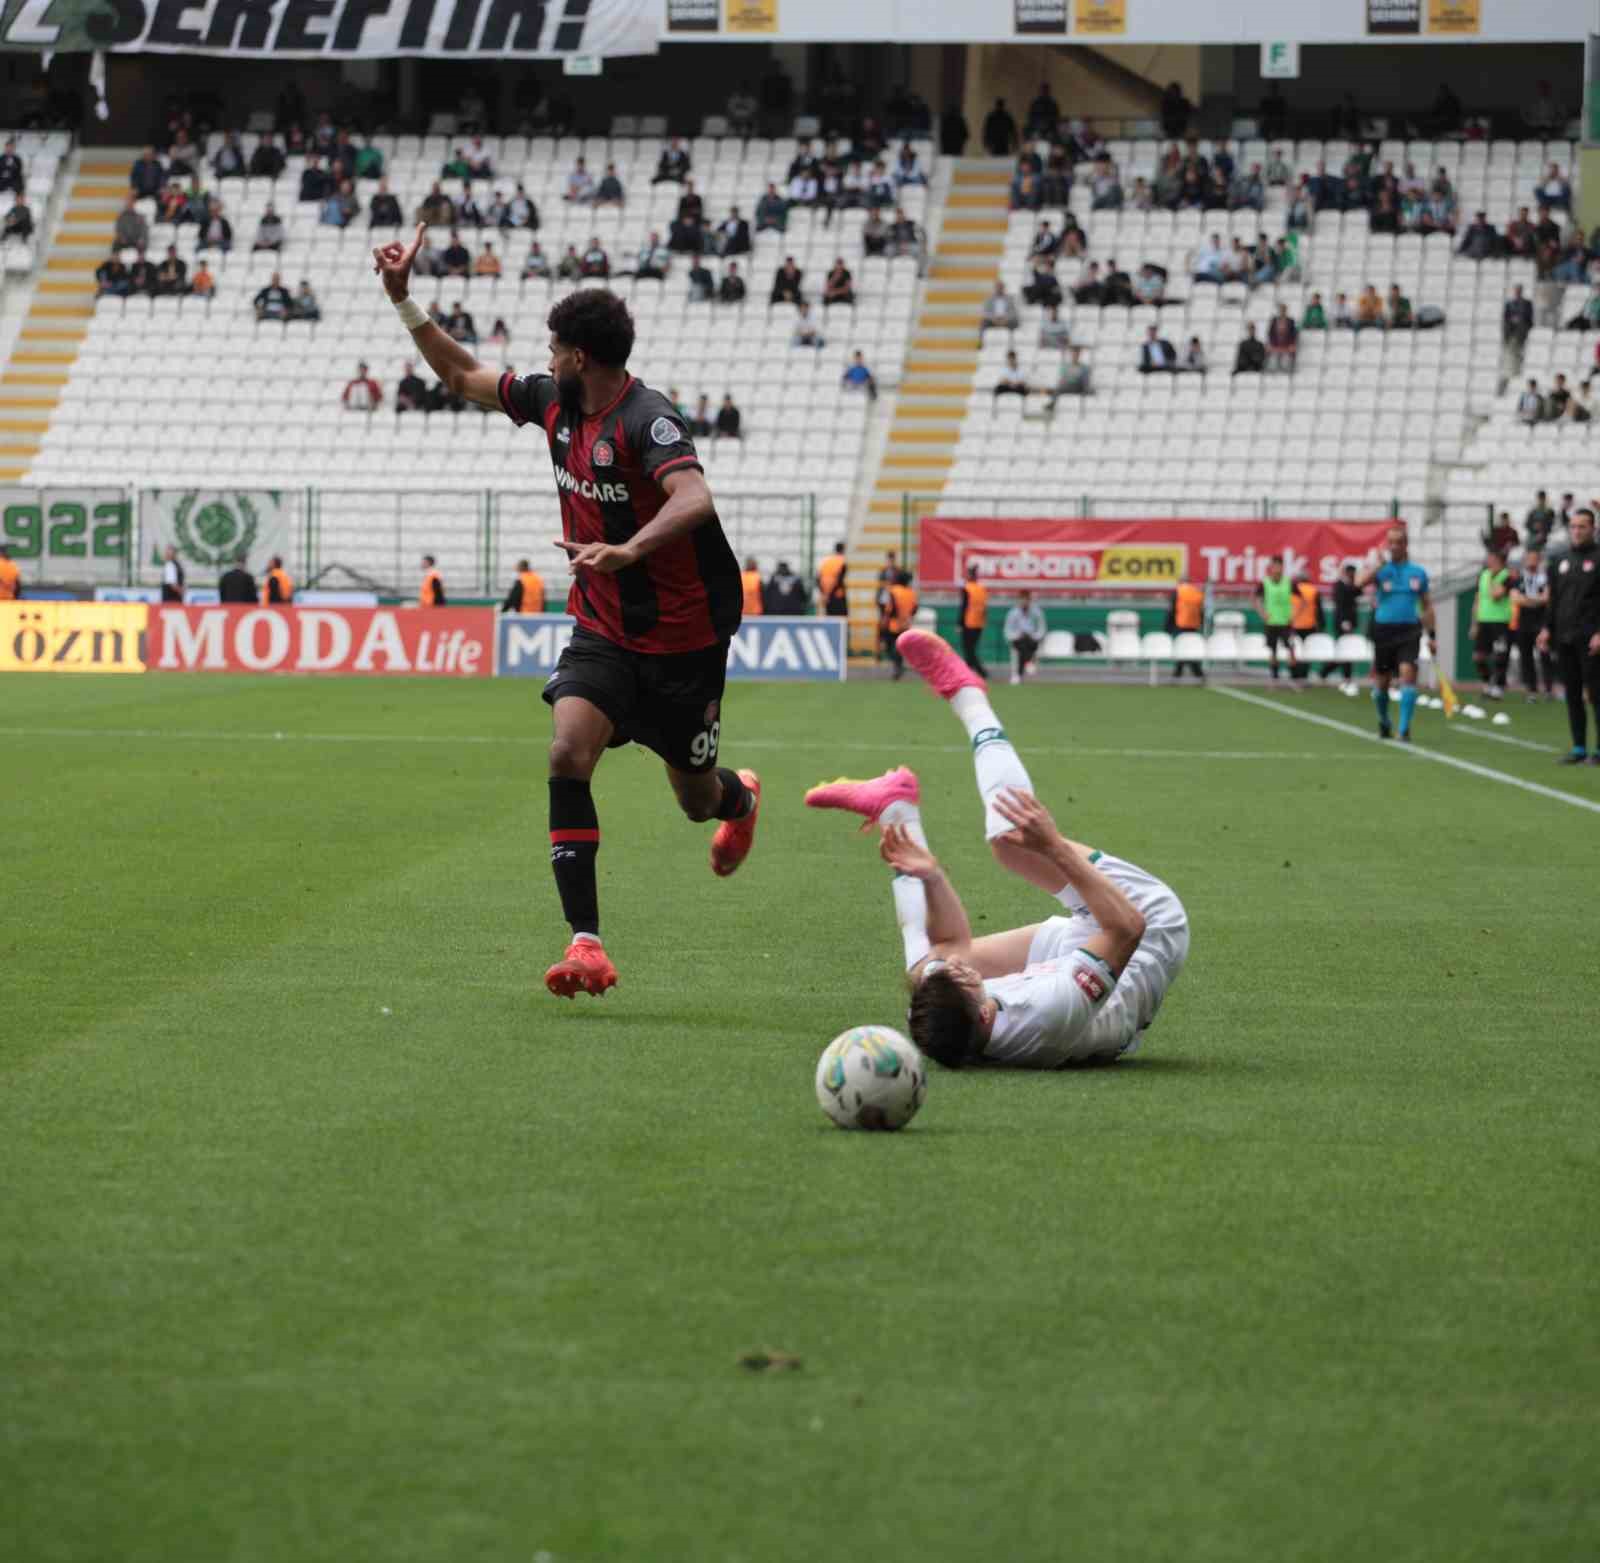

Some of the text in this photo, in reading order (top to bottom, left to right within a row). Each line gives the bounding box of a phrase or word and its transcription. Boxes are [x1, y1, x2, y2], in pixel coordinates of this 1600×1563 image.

[159, 610, 482, 673] MODA Life
[690, 721, 719, 765] 99
